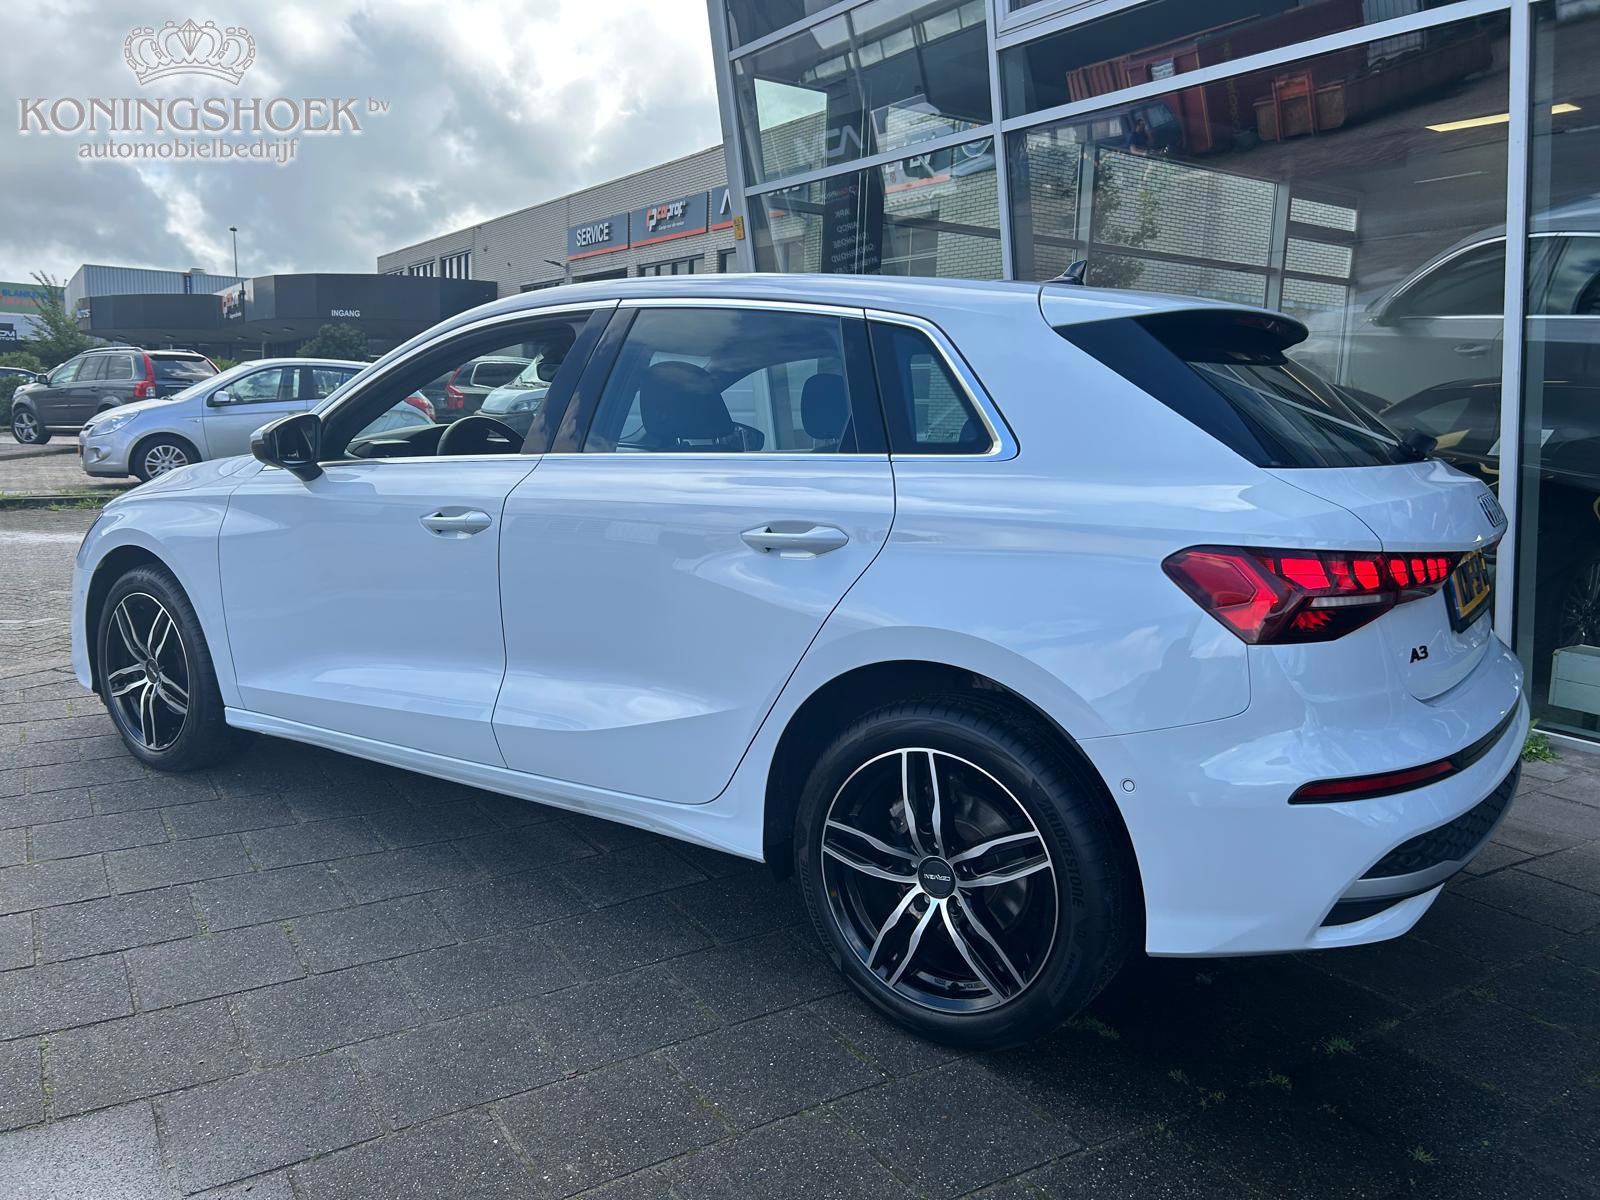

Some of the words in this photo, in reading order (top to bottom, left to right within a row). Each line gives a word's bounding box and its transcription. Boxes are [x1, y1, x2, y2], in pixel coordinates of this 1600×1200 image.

[576, 222, 609, 247] SERVICE
[331, 309, 361, 318] INGANG
[1410, 645, 1429, 663] A3
